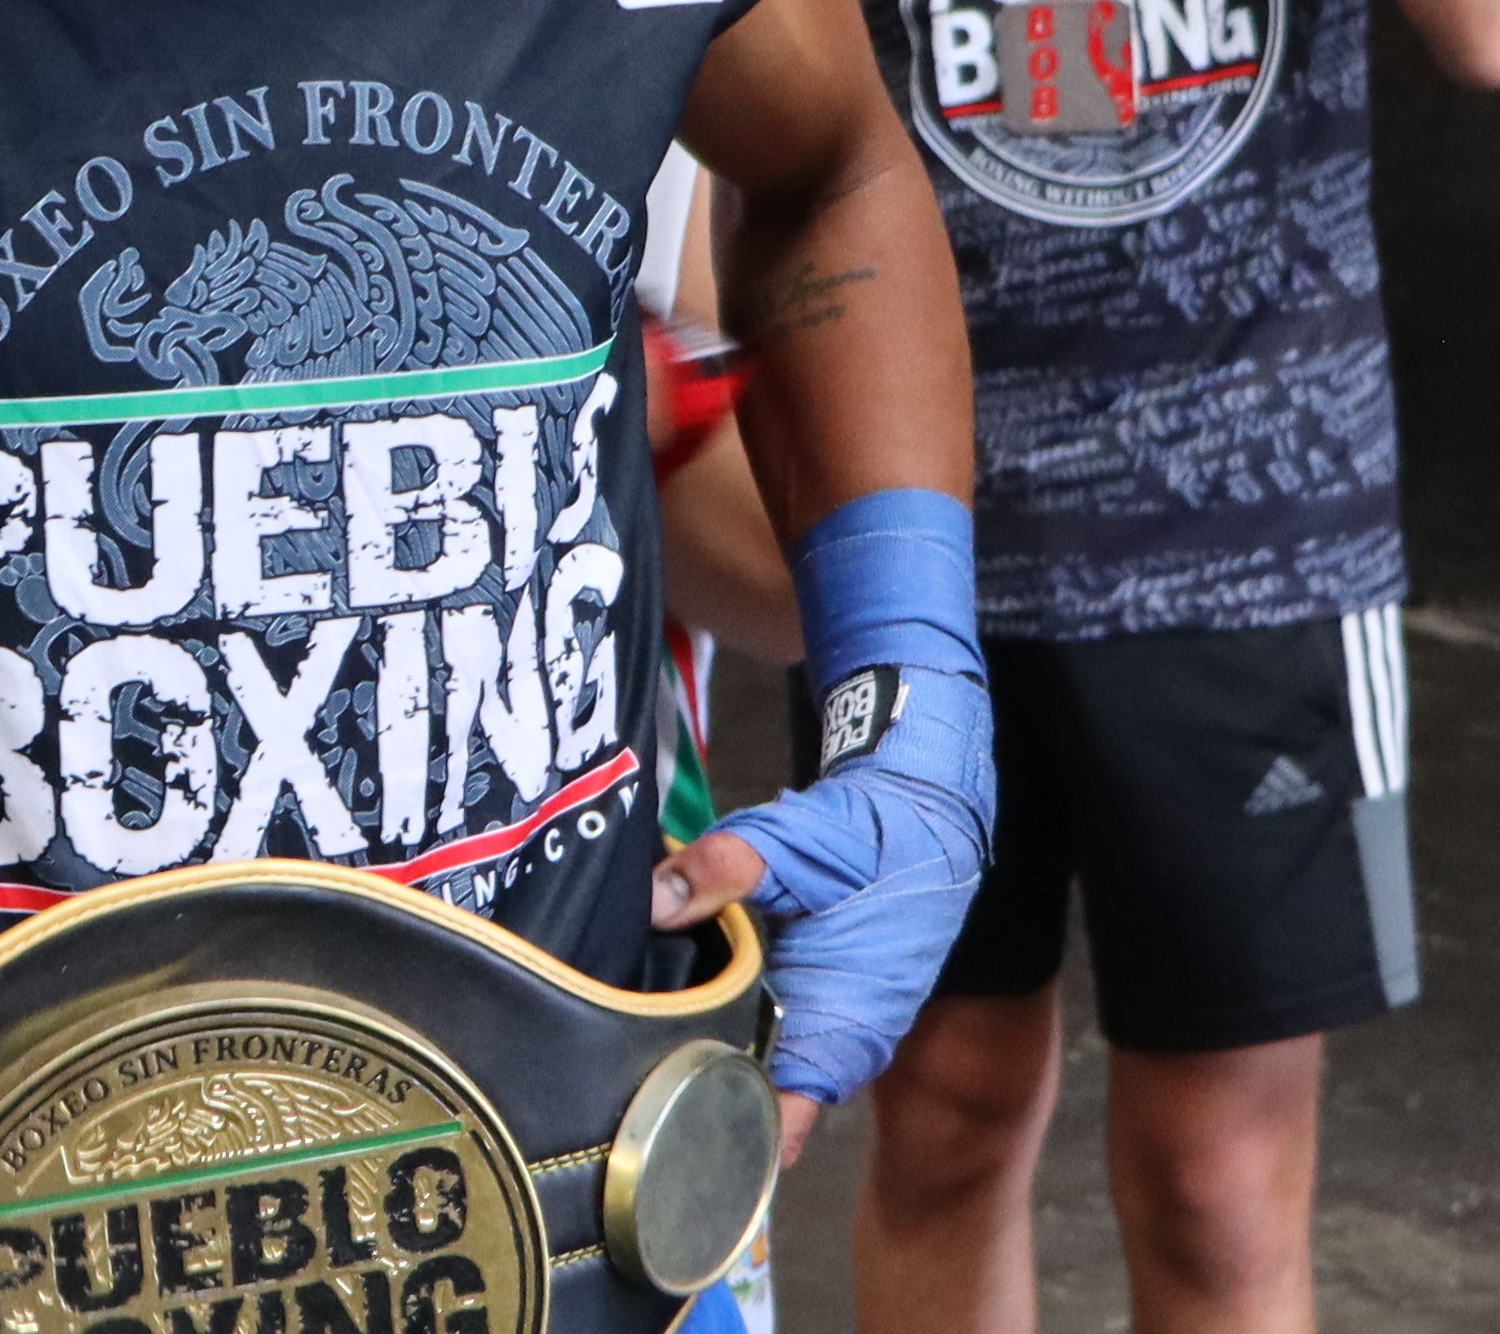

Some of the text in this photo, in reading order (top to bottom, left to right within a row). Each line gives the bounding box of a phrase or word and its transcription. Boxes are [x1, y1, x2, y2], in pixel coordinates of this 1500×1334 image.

[143, 85, 277, 188] SIN
[1, 1034, 412, 1177] BOXEO SIN FRONTERAS
